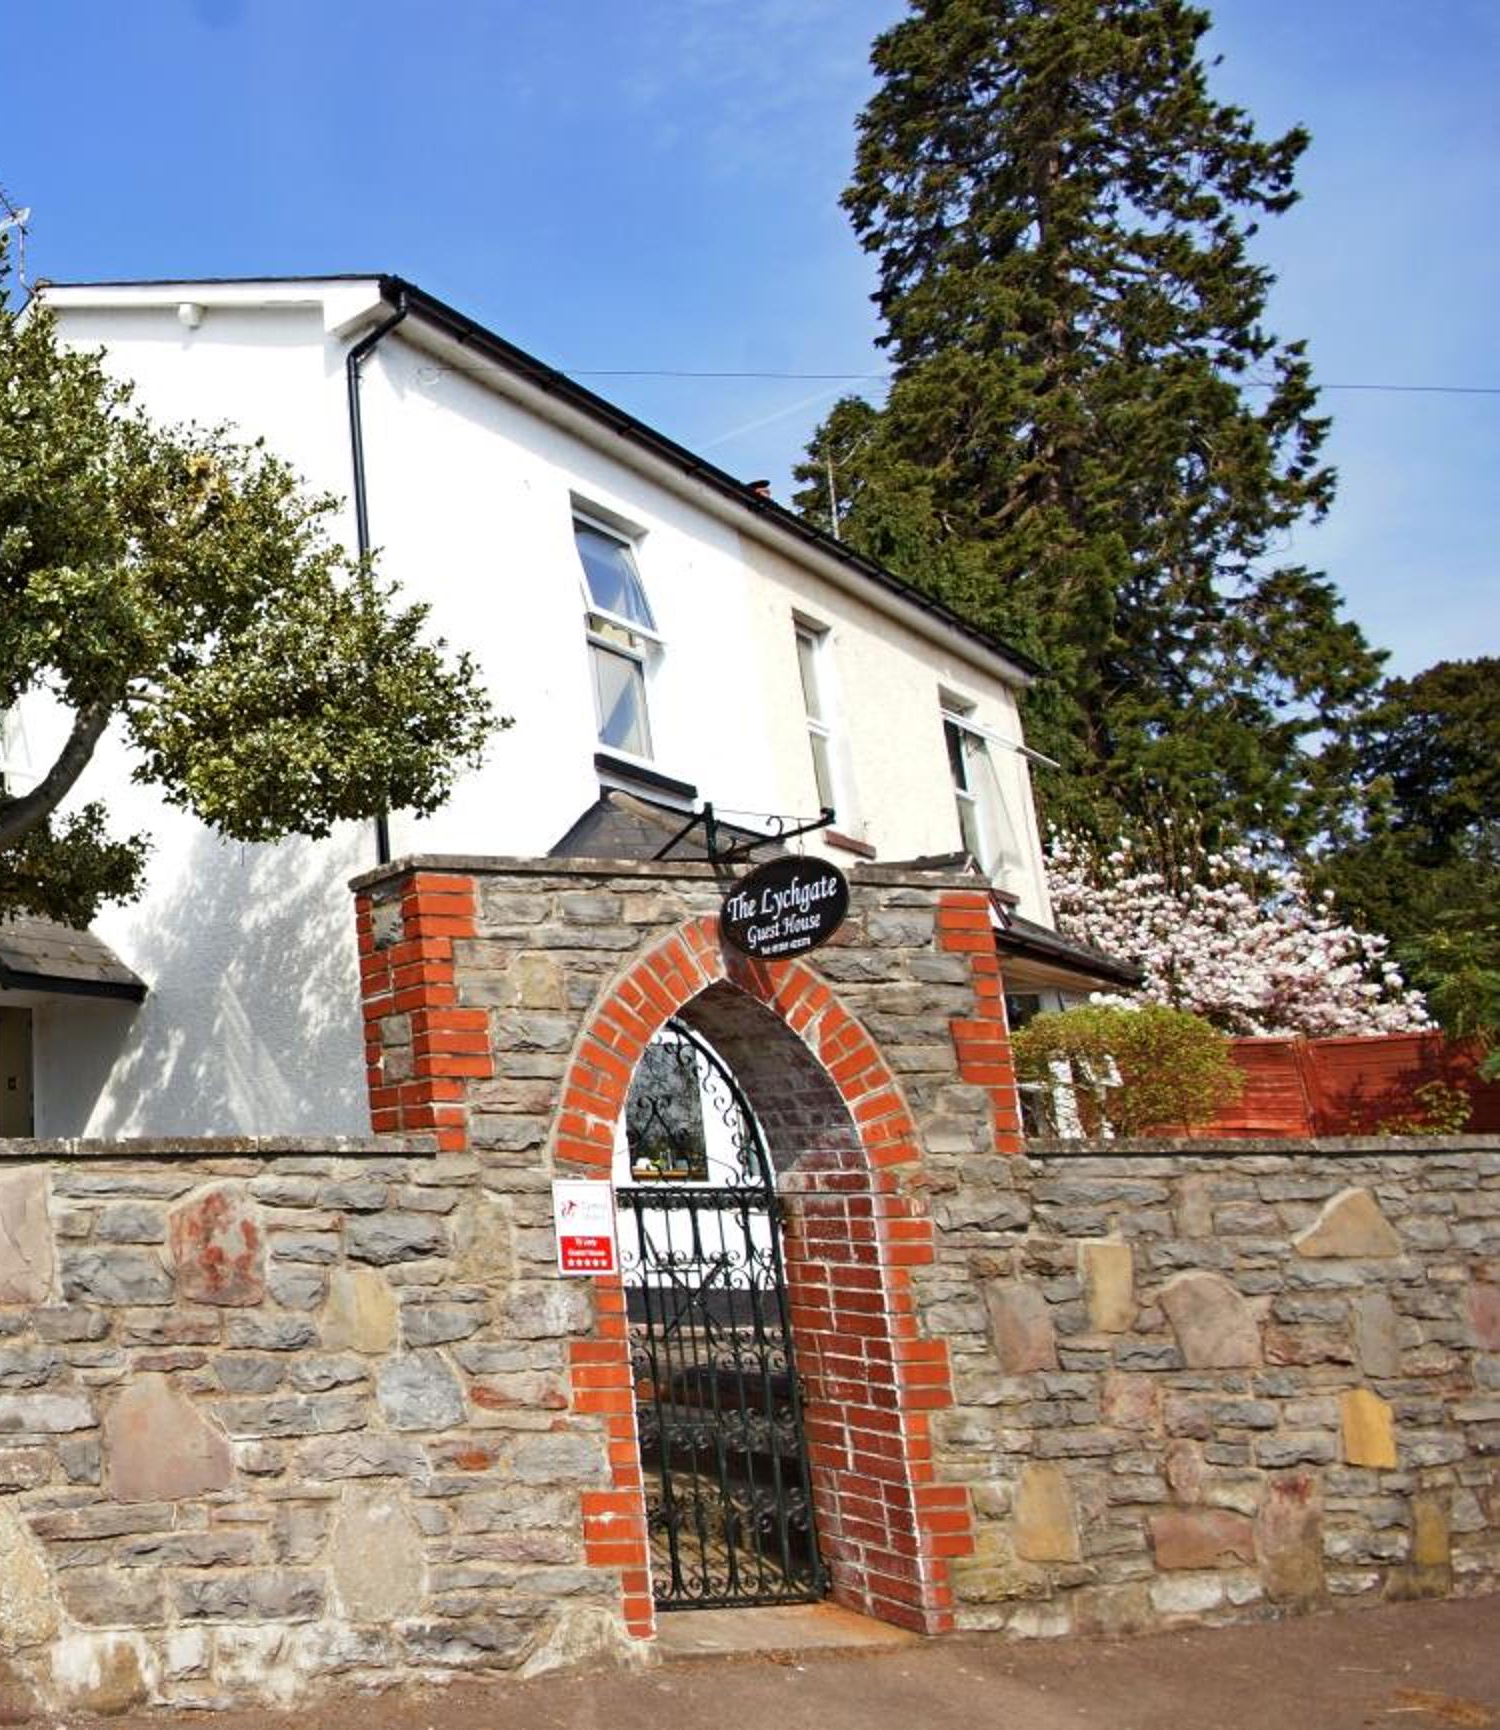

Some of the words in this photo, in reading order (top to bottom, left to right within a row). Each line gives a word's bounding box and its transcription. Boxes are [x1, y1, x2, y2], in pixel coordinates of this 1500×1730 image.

[727, 891, 756, 921] The
[760, 876, 837, 920] Lychgate
[747, 925, 780, 949] Guest
[782, 913, 821, 936] House
